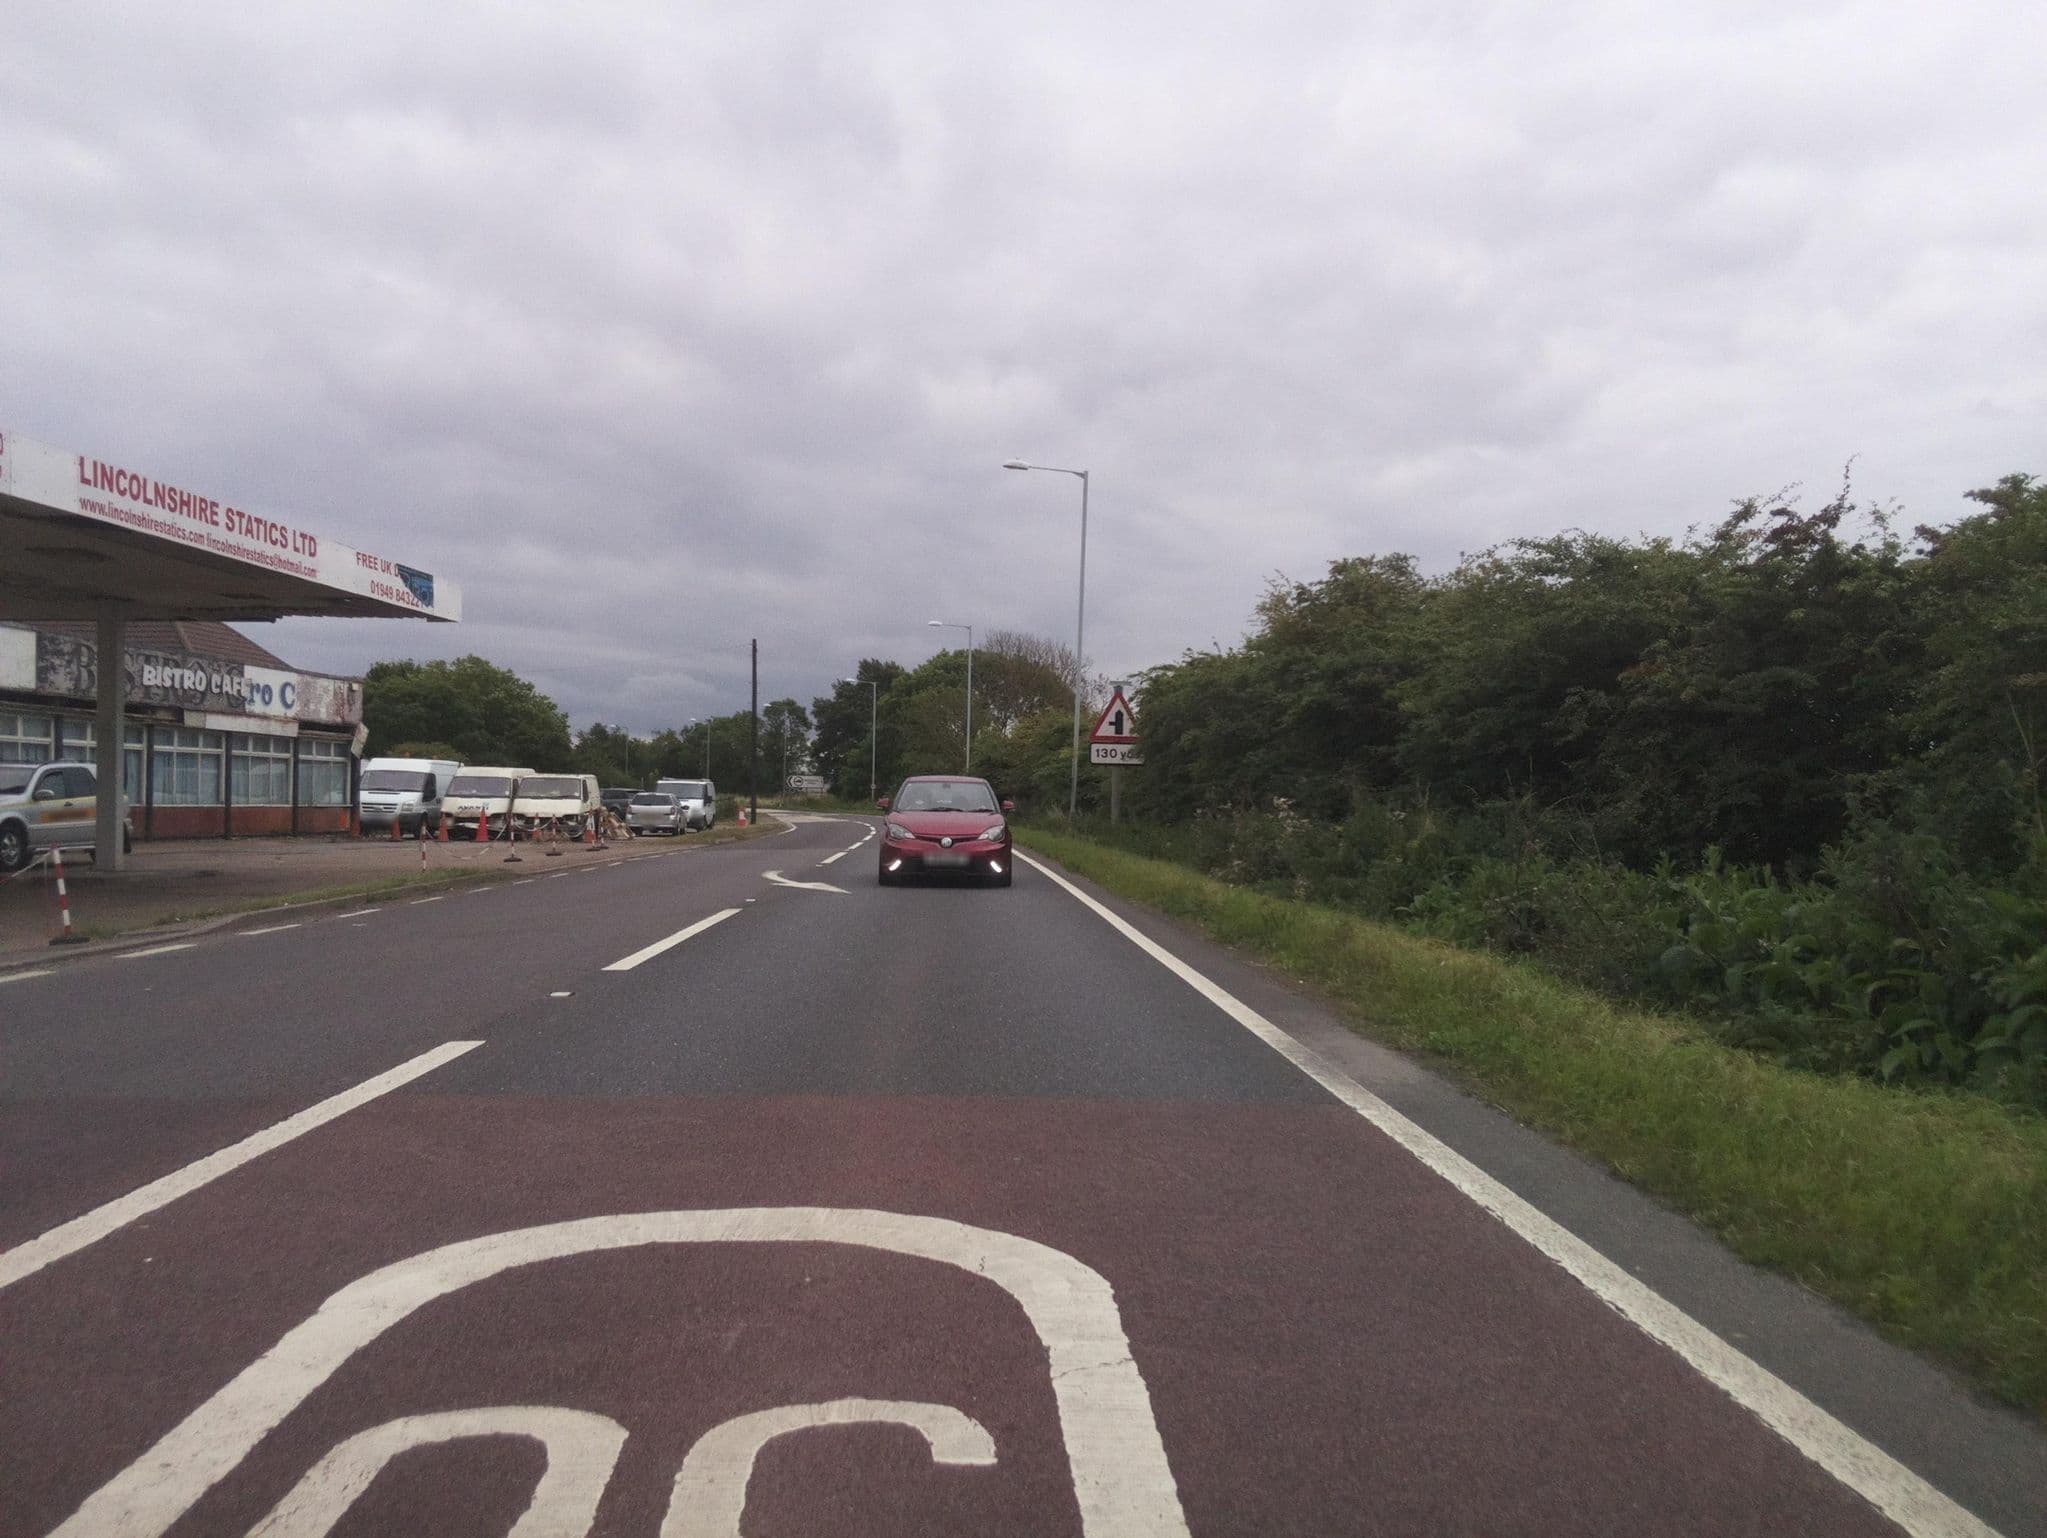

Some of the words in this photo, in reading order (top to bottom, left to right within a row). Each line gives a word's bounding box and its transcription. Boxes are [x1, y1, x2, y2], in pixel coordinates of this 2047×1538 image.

[79, 455, 219, 526] LINCOLNSHIRE
[225, 507, 288, 549] STATICS
[293, 529, 317, 557] LTD
[79, 498, 205, 545] www.lincolnshirestatics.com
[356, 552, 378, 571] FREE
[381, 559, 393, 576] UK
[370, 580, 394, 600] 01949
[395, 588, 423, 609] 84322
[142, 664, 207, 692] BISTRO
[1095, 748, 1118, 758] 130
